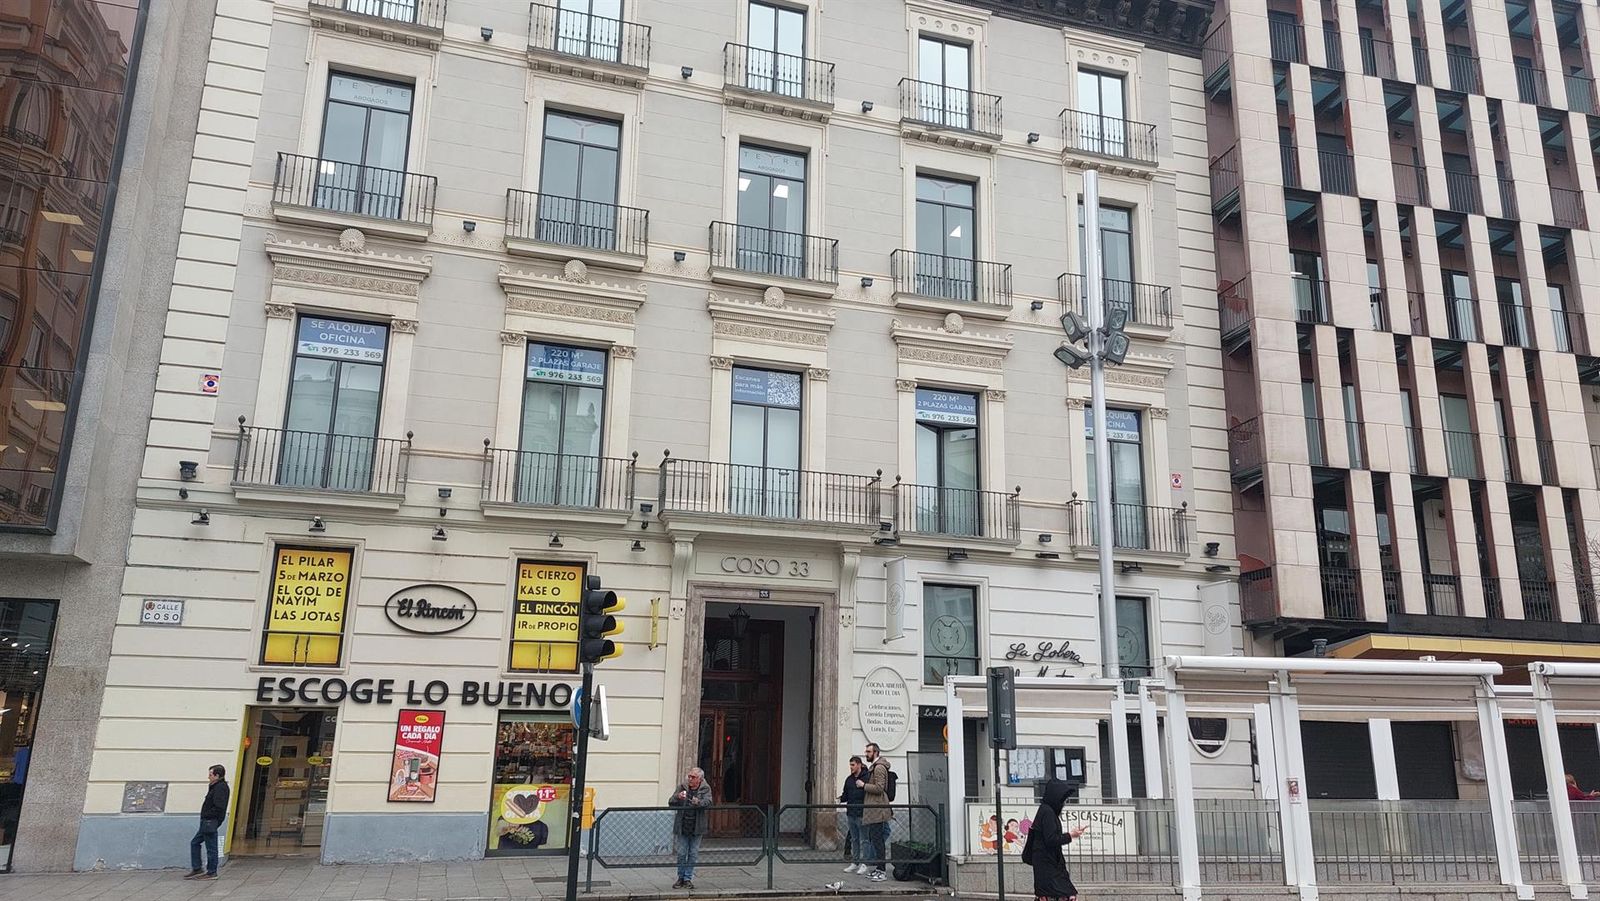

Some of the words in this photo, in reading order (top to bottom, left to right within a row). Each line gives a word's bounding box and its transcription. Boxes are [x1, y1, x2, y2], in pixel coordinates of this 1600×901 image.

[311, 320, 326, 329] SE
[327, 322, 377, 336] ALQUILA
[319, 332, 366, 346] OFICINA
[321, 345, 339, 355] 976
[343, 348, 360, 357] 233
[363, 351, 382, 360] 569
[551, 349, 569, 358] 220
[538, 357, 570, 367] PLAZAS
[570, 360, 602, 370] GARAJE
[548, 371, 564, 379] 976
[568, 373, 583, 381] 233
[586, 375, 602, 383] 569
[932, 393, 948, 402] 220
[922, 400, 949, 409] PLAZAS
[948, 403, 974, 412] GARAJE
[931, 412, 945, 421] 976
[947, 414, 960, 422] 233
[1106, 411, 1133, 421] QUILA
[1112, 431, 1125, 439] 233
[281, 555, 294, 566] EL
[298, 556, 335, 568] PILAR
[720, 556, 780, 575] COSO
[788, 560, 809, 577] 33
[278, 570, 286, 580] 5
[298, 571, 345, 583] MARZO
[521, 569, 533, 579] EL
[536, 570, 577, 581] CIERZO
[277, 585, 290, 595] EL
[294, 585, 322, 597] GOL
[326, 587, 342, 597] DE
[520, 585, 547, 596] KASE
[551, 586, 561, 596] O
[760, 590, 769, 598] 33
[156, 603, 180, 611] CALLE
[275, 595, 318, 607] NAYIM
[397, 598, 414, 618] El
[414, 598, 466, 620] Rincón
[519, 603, 532, 613] EL
[535, 602, 578, 615] RINCÓN
[144, 612, 179, 621] COSO
[273, 609, 297, 620] LAS
[300, 610, 341, 622] JOTAS
[518, 620, 528, 629] IR
[537, 621, 578, 631] PROPIO
[1005, 642, 1032, 660] La
[1032, 641, 1085, 667] Lobera
[256, 676, 395, 705] ESCOGE
[406, 679, 450, 706] LO
[461, 680, 572, 707] BUENO
[923, 708, 933, 717] La
[400, 725, 412, 733] UN
[413, 724, 441, 734] REGALO
[401, 732, 422, 740] CADA
[1080, 811, 1123, 828] CASTILLA
